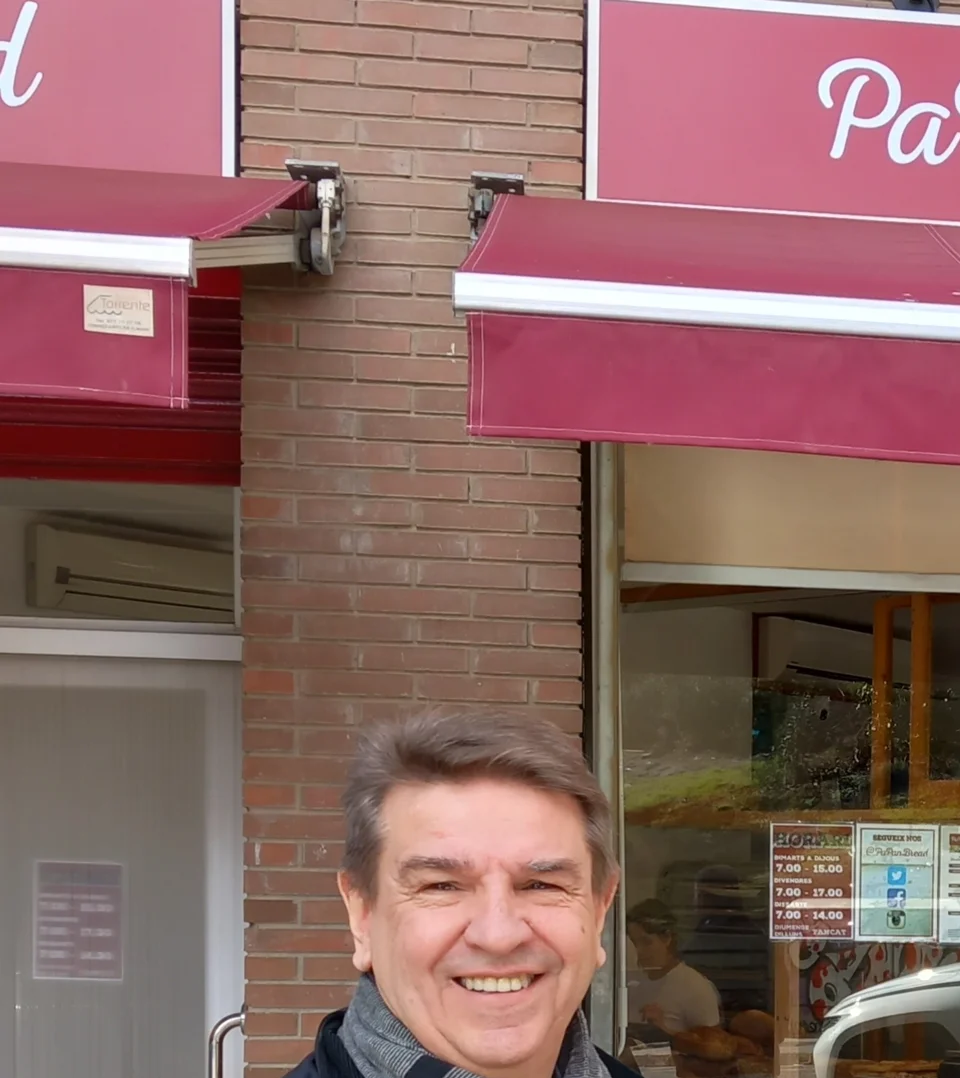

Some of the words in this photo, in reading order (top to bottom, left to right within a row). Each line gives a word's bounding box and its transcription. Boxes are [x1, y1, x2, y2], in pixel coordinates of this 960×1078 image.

[776, 863, 802, 873] 7.00
[812, 864, 843, 873] 15.00
[776, 888, 802, 897] 7.00
[812, 888, 843, 897] 17.00
[775, 910, 801, 920] 7.00
[812, 911, 844, 920] 14.00
[812, 928, 846, 936] TANCAT
